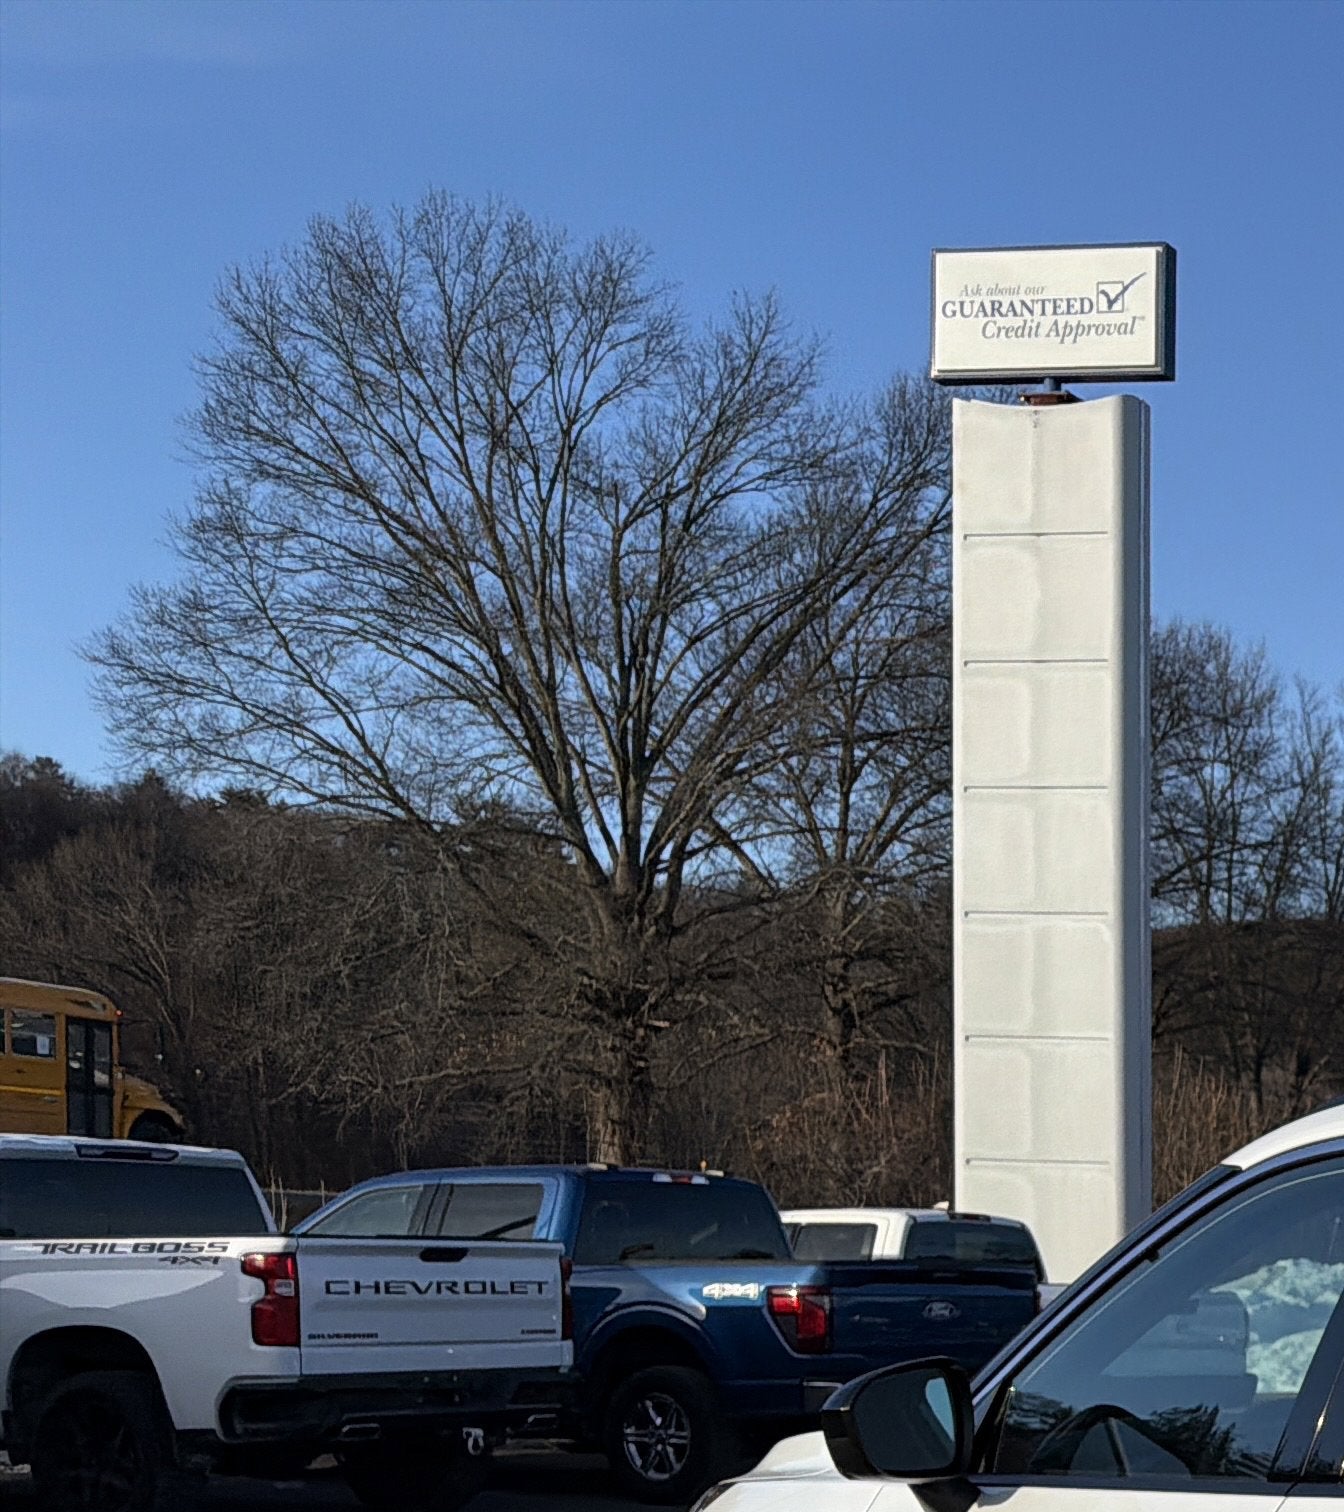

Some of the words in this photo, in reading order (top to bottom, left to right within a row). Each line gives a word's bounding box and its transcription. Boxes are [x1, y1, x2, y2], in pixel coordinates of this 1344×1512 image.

[960, 284, 983, 298] Ask
[986, 283, 1022, 297] about
[1024, 285, 1045, 296] our
[942, 297, 1094, 318] GUARANTEED
[981, 319, 1041, 340] Credit
[31, 1242, 128, 1255] TRAIL
[132, 1241, 230, 1254] BOSS
[324, 1280, 549, 1295] CHEVROLET
